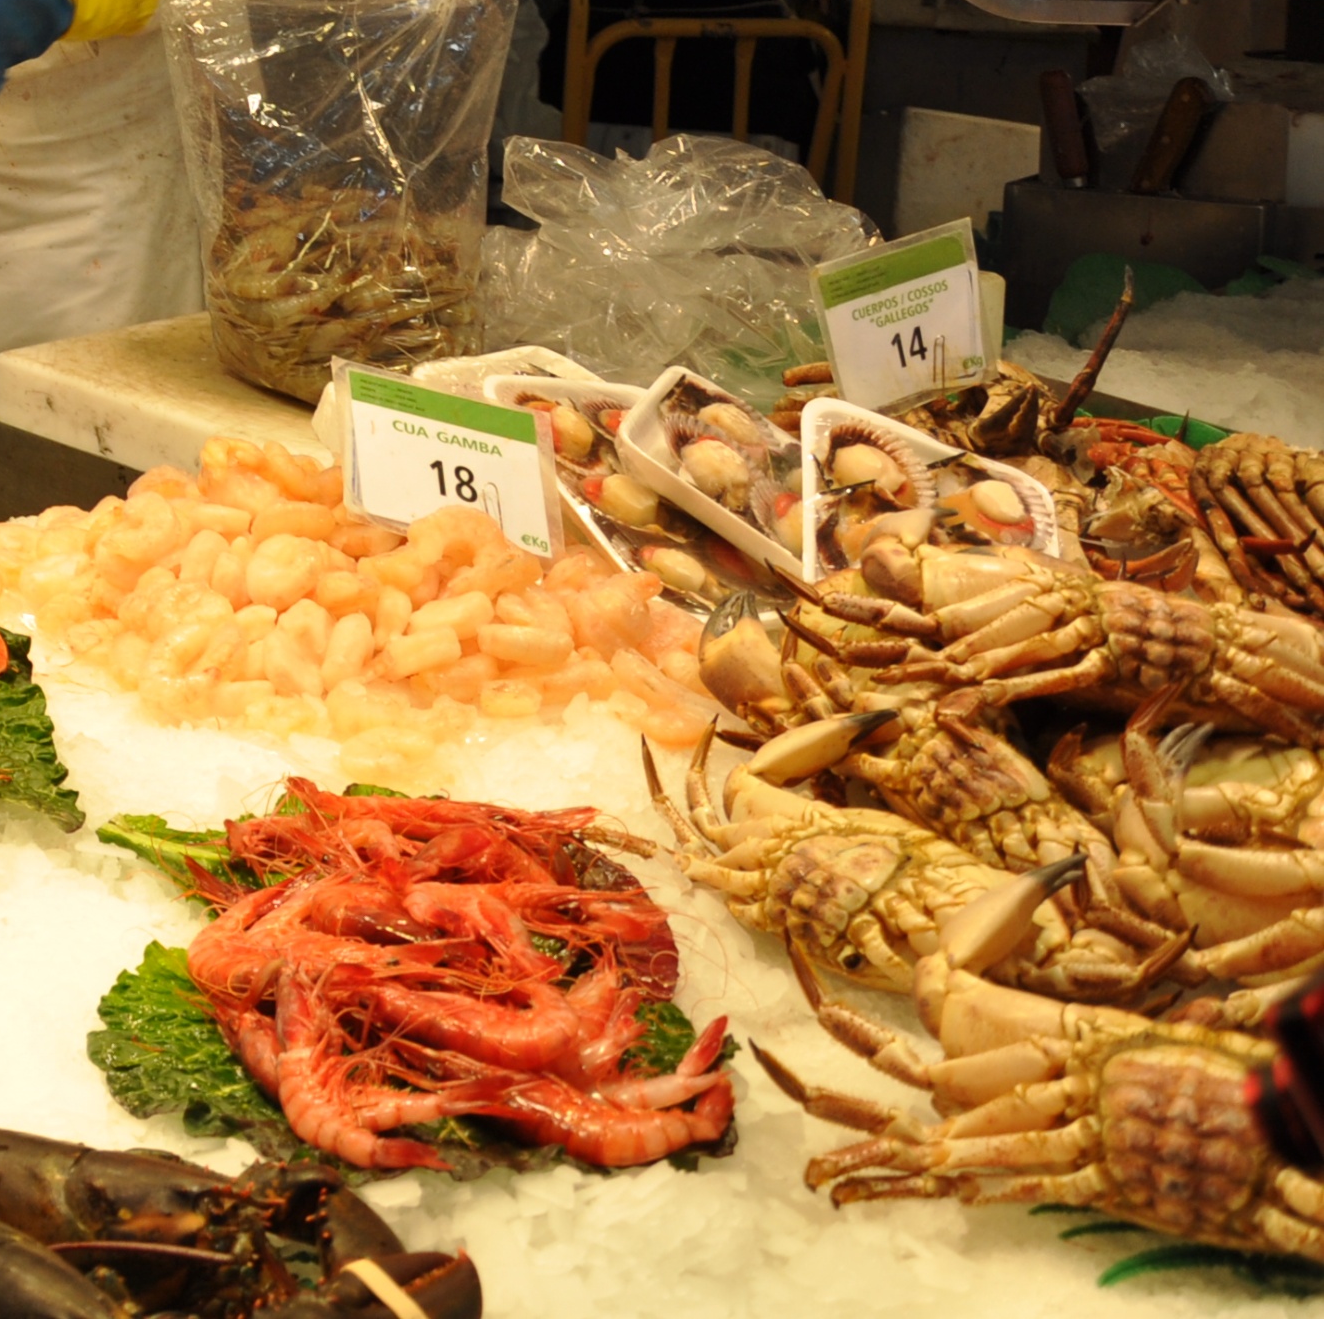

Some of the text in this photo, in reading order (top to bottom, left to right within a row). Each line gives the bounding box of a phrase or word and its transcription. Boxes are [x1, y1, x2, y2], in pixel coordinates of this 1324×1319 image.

[851, 295, 899, 322] CUERPOS
[907, 279, 949, 303] COSSOS
[890, 325, 928, 369] 14
[392, 419, 503, 458] CUA GAMBA
[429, 459, 479, 504] 18
